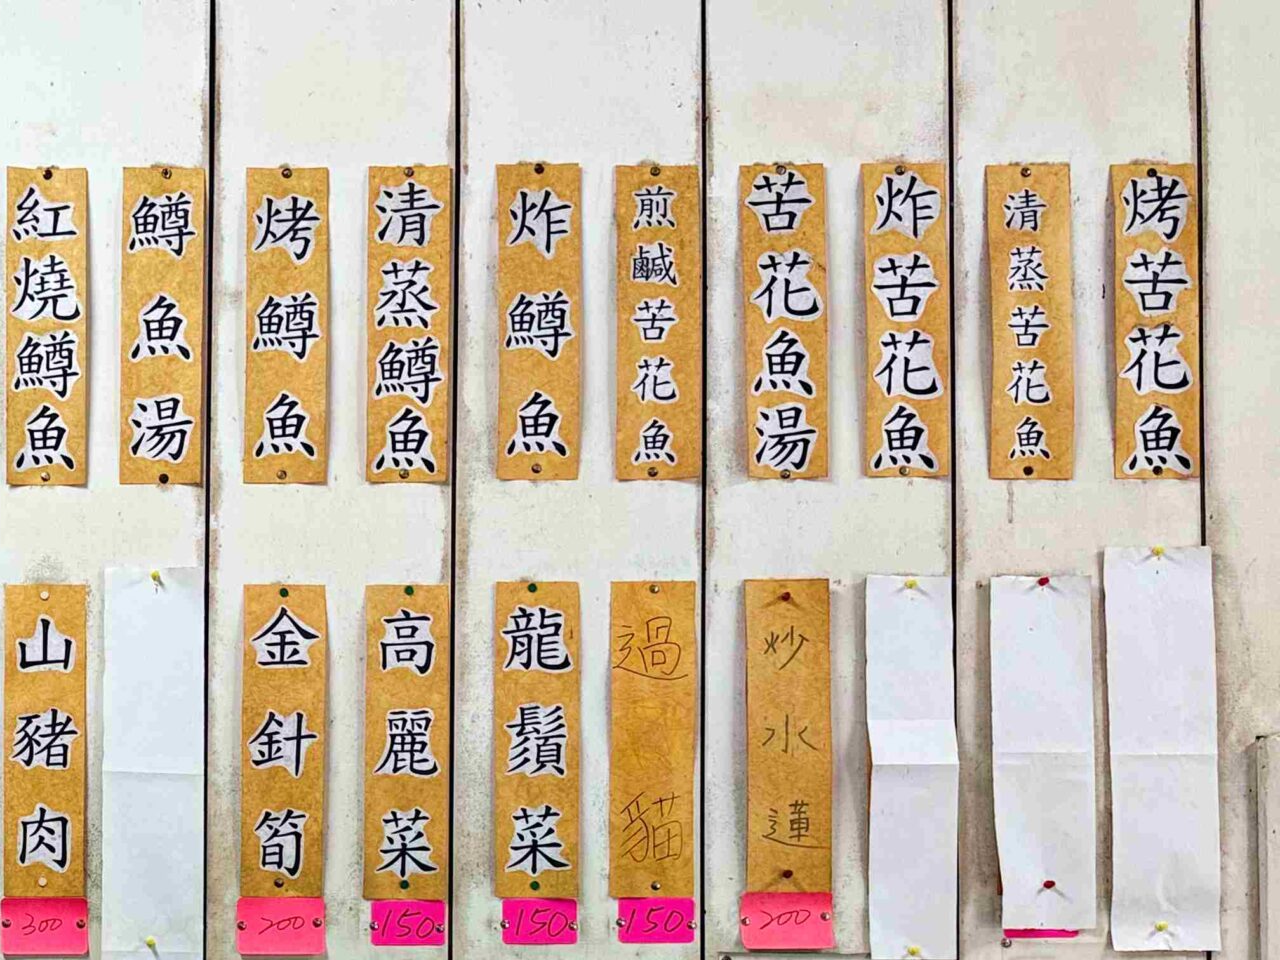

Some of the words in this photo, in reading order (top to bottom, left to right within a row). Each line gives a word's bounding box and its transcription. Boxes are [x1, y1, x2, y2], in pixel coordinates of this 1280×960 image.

[11, 188, 80, 471] 紅燒鱒魚
[128, 196, 196, 461] 鱒魚湯
[253, 198, 321, 456] 烤鱒魚
[375, 185, 444, 469] 清蒸鱒魚
[507, 192, 572, 455] 炸鱒魚
[630, 187, 678, 464] 煎鹹苦花魚
[749, 174, 821, 467] 苦花魚湯
[871, 177, 941, 469] 炸苦花魚
[1004, 190, 1050, 457] 清蒸苦花魚
[1122, 180, 1193, 470] 烤苦花魚
[12, 620, 77, 867] 山豬肉
[250, 608, 320, 877] 金針筍
[375, 609, 438, 875] 高麗菜
[503, 606, 570, 872] 龍鬚菜
[21, 912, 63, 932] 300
[261, 911, 308, 935] 200
[377, 910, 435, 938] 150
[512, 910, 571, 938] 150
[625, 910, 686, 938] 150
[762, 908, 812, 930] 200
